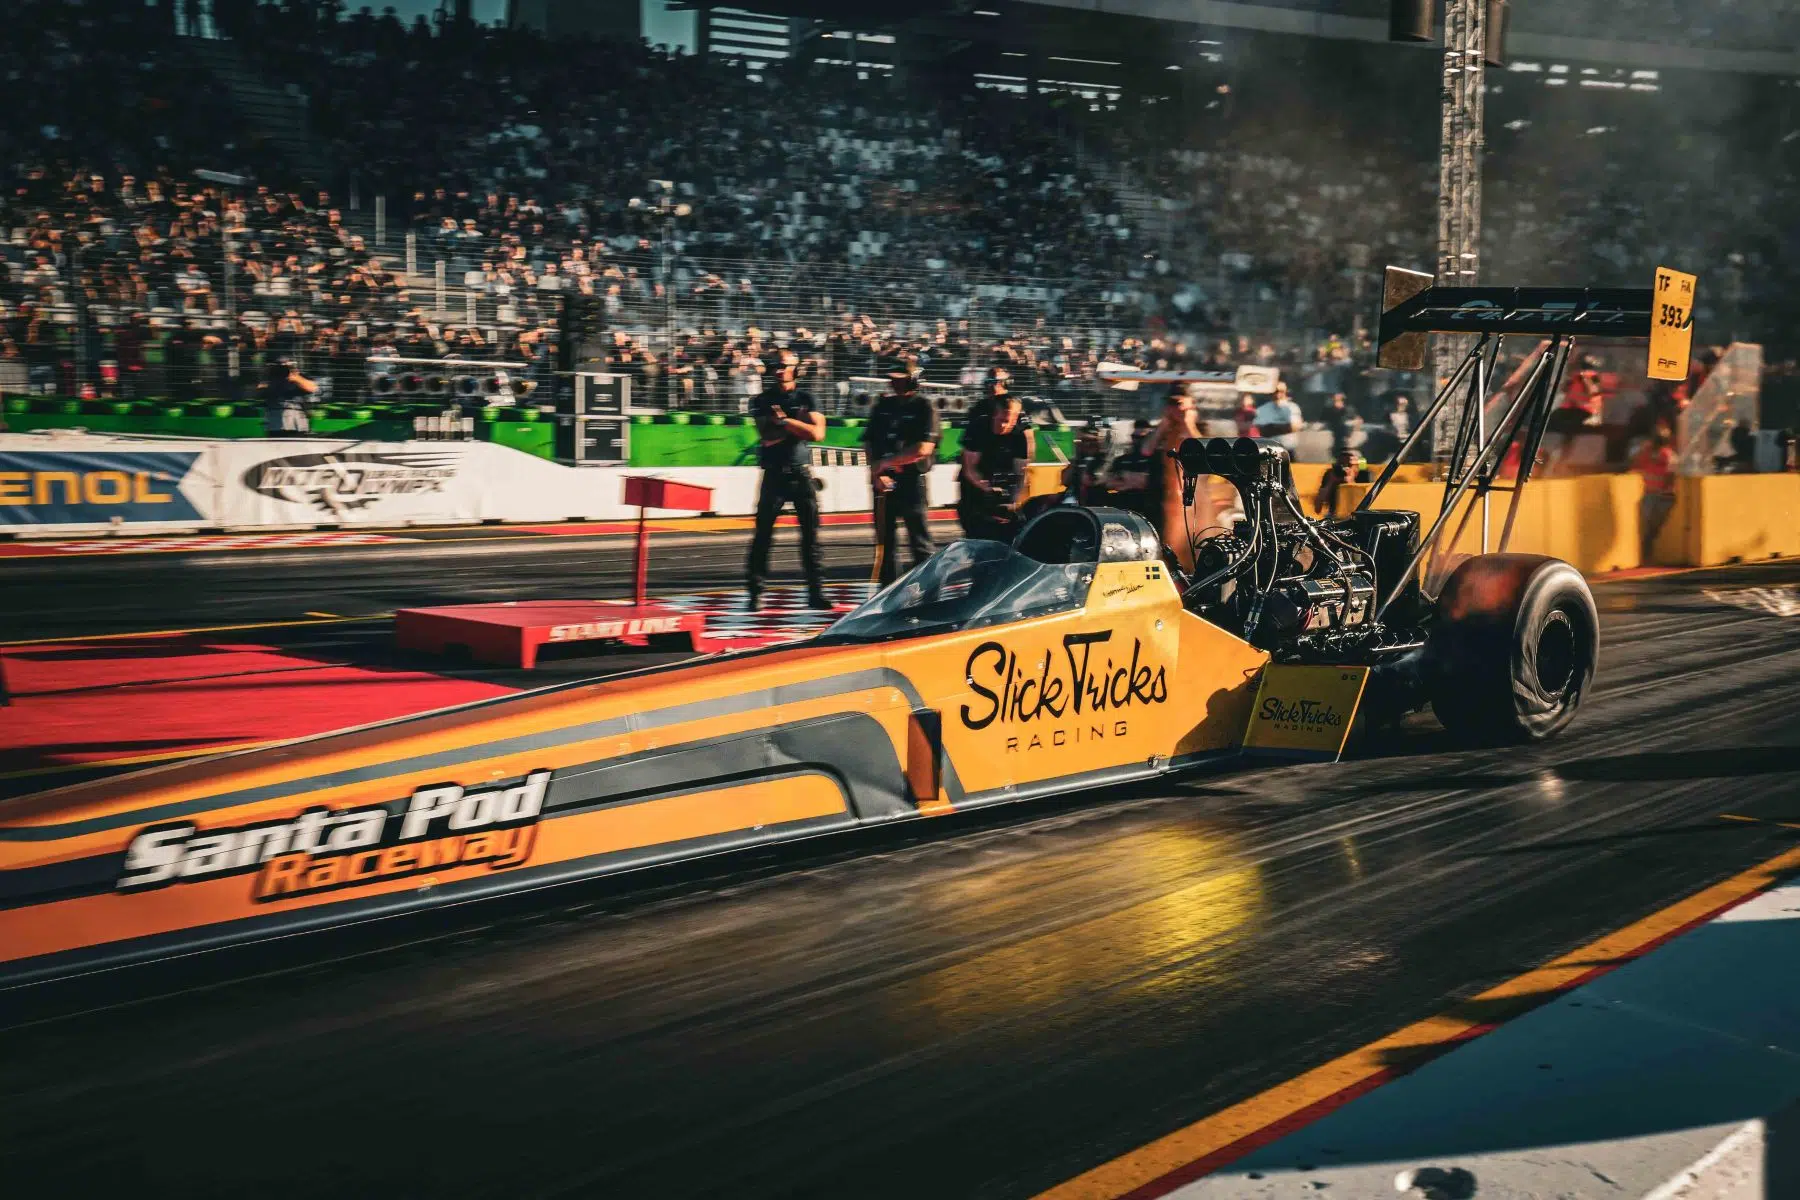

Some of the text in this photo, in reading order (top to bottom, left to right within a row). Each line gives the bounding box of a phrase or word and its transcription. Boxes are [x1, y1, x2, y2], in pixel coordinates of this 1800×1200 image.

[1658, 275, 1671, 292] TF
[1660, 304, 1683, 329] 393
[548, 616, 683, 642] START LINE
[960, 629, 1168, 731] Slick Tricks
[1259, 697, 1342, 726] Slick Tricks
[1006, 720, 1128, 754] RACING
[115, 770, 553, 889] Santa Pod
[254, 824, 537, 900] Raceway
